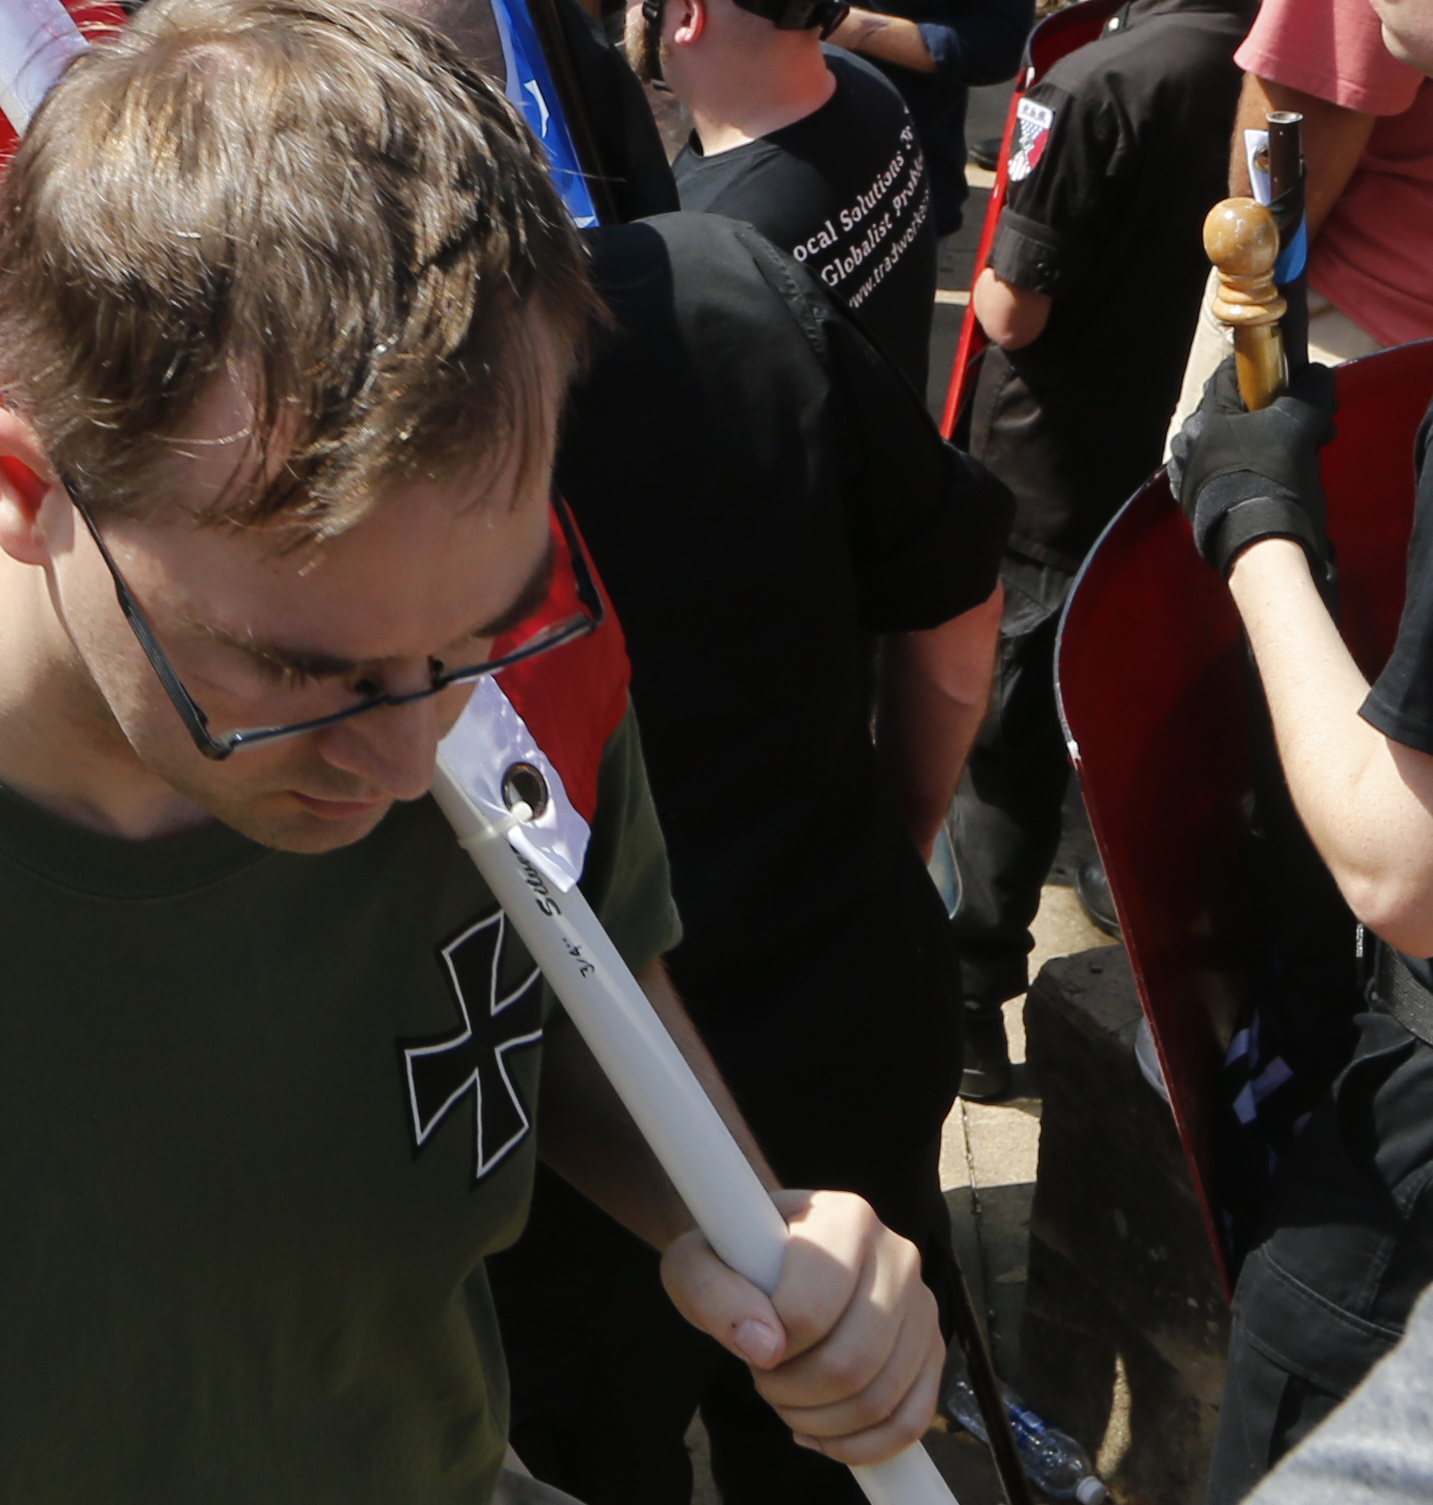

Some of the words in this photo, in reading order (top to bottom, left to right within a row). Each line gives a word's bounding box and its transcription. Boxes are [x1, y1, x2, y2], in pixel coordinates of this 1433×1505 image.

[792, 219, 839, 263] ocal
[839, 150, 906, 232] Solutions
[820, 212, 893, 287] Globalist
